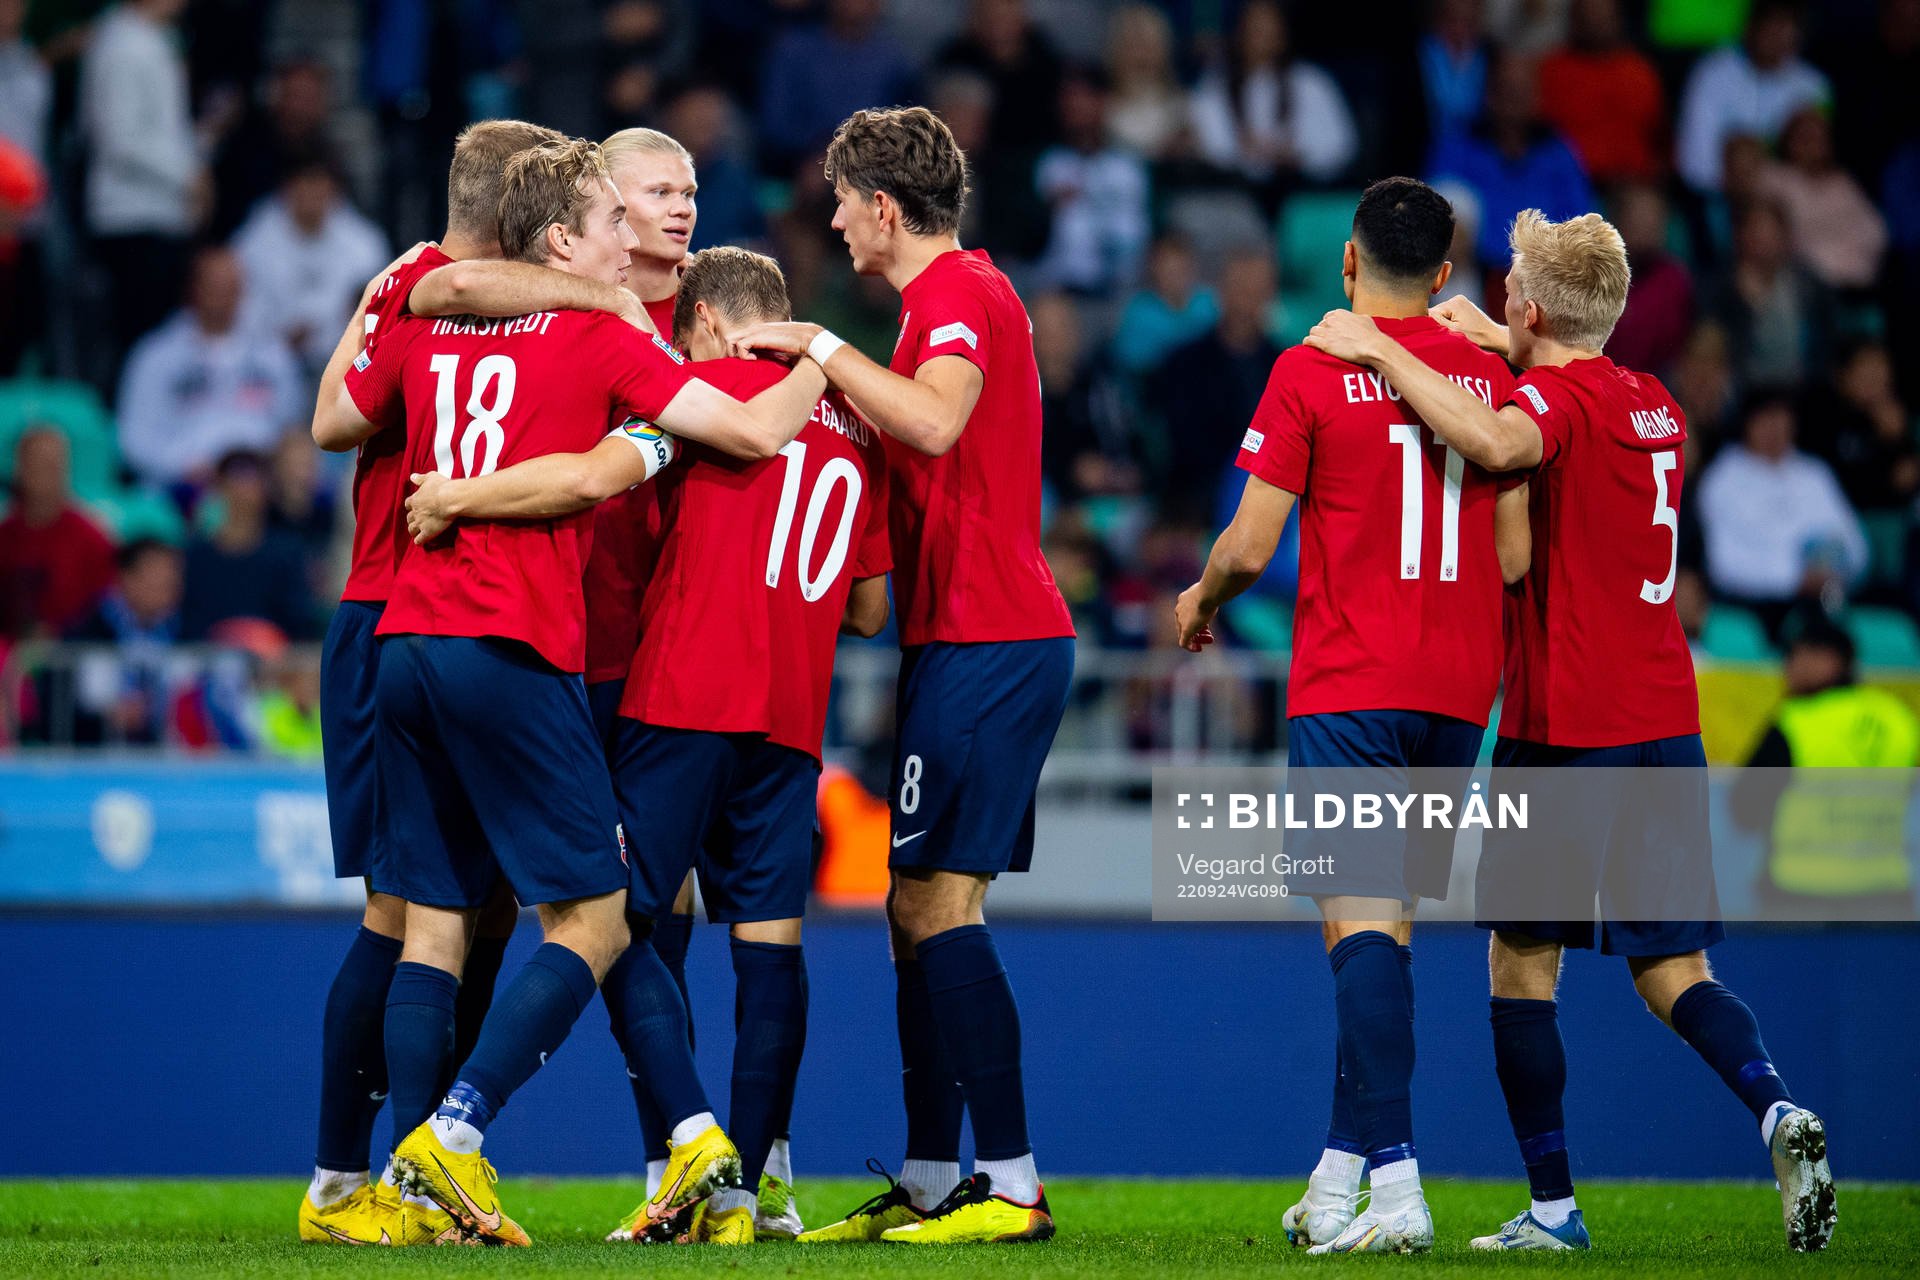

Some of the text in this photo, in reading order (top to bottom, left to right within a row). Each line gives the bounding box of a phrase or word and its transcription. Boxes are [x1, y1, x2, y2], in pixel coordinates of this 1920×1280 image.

[429, 353, 517, 480] 18
[809, 399, 869, 448] EGAARD
[765, 440, 863, 603] 10
[1389, 424, 1465, 582] 11
[1640, 451, 1678, 604] 5
[900, 754, 923, 815] 8
